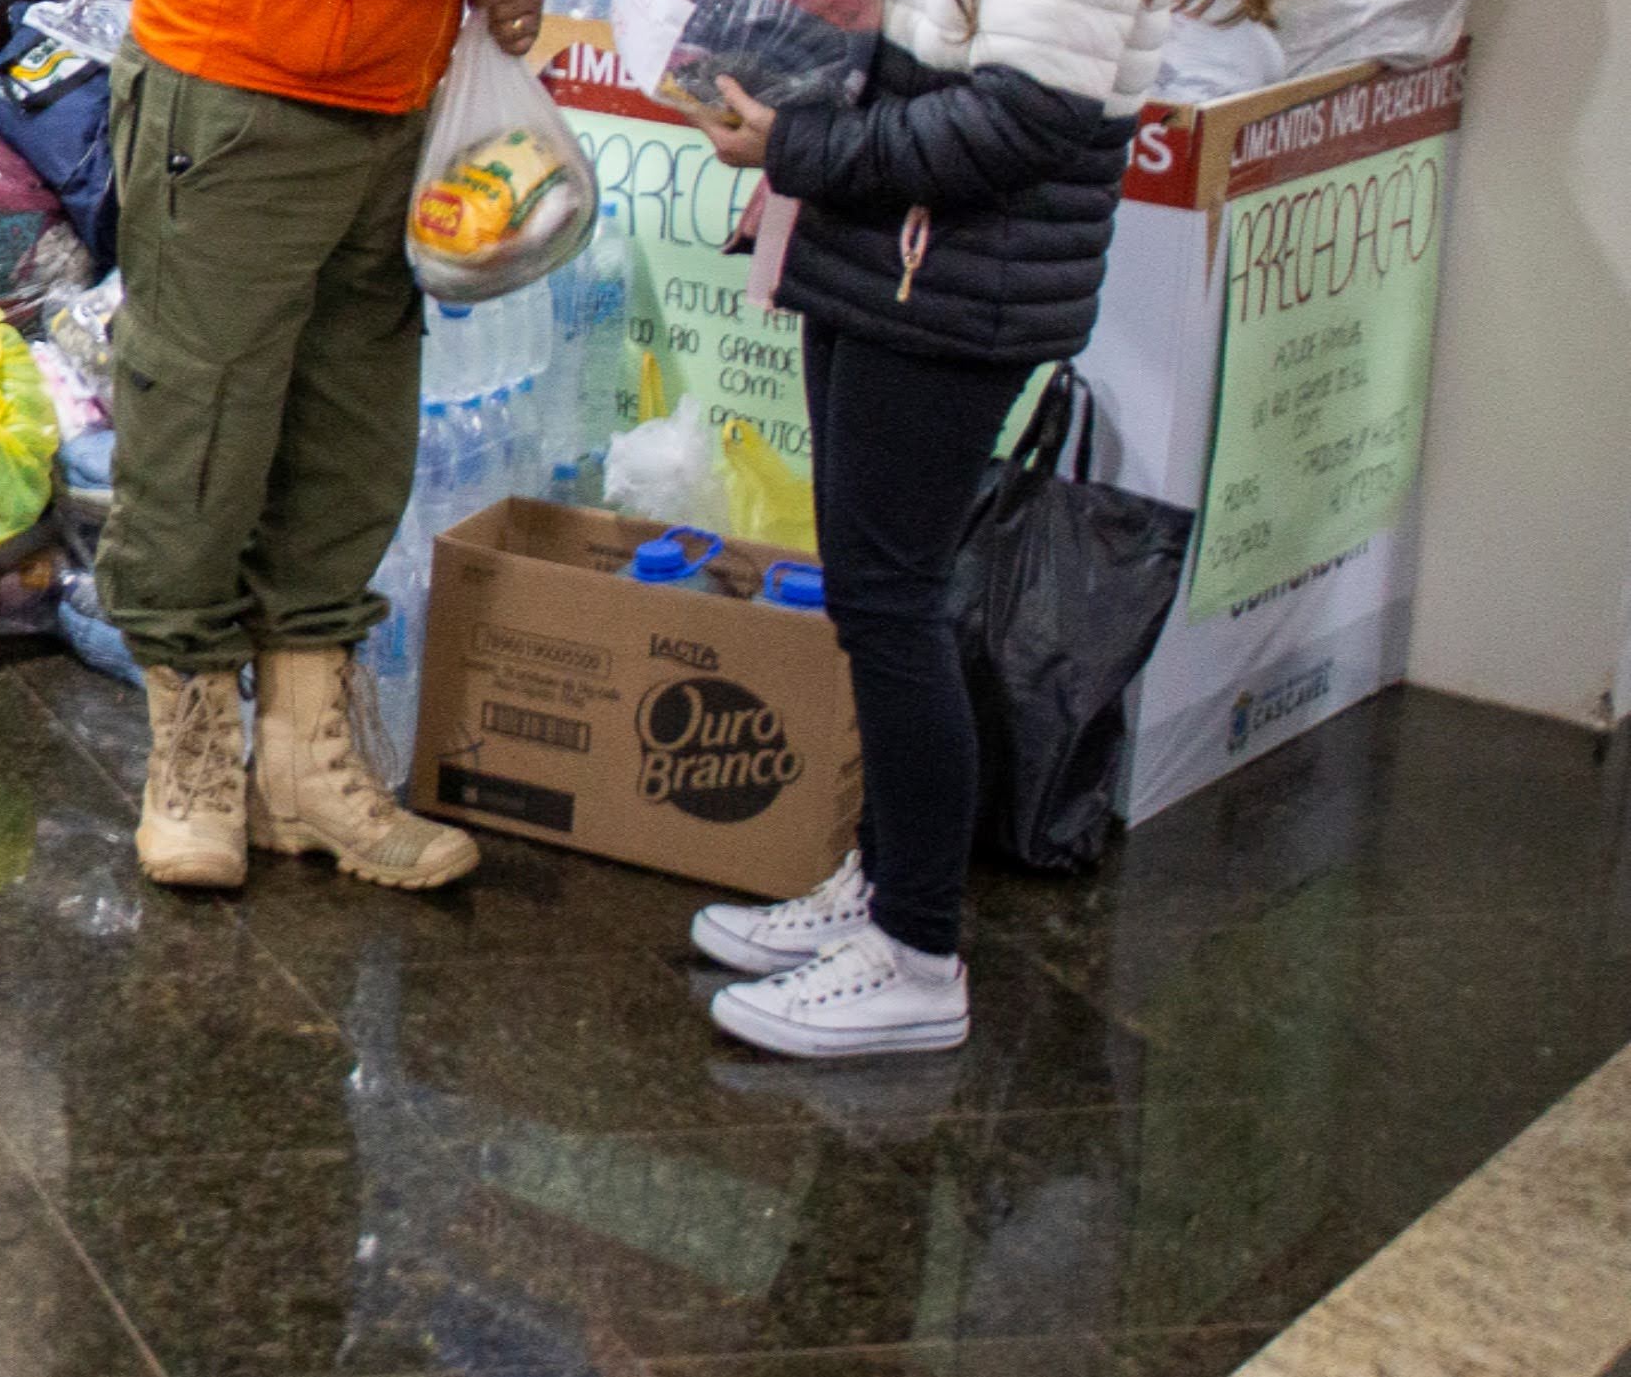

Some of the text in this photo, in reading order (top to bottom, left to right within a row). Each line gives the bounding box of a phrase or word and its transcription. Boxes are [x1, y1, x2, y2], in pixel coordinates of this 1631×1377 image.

[665, 277, 747, 322] AJUDE
[718, 334, 799, 378] GRANDE
[637, 682, 782, 753] Ouro
[639, 745, 805, 803] Branco
